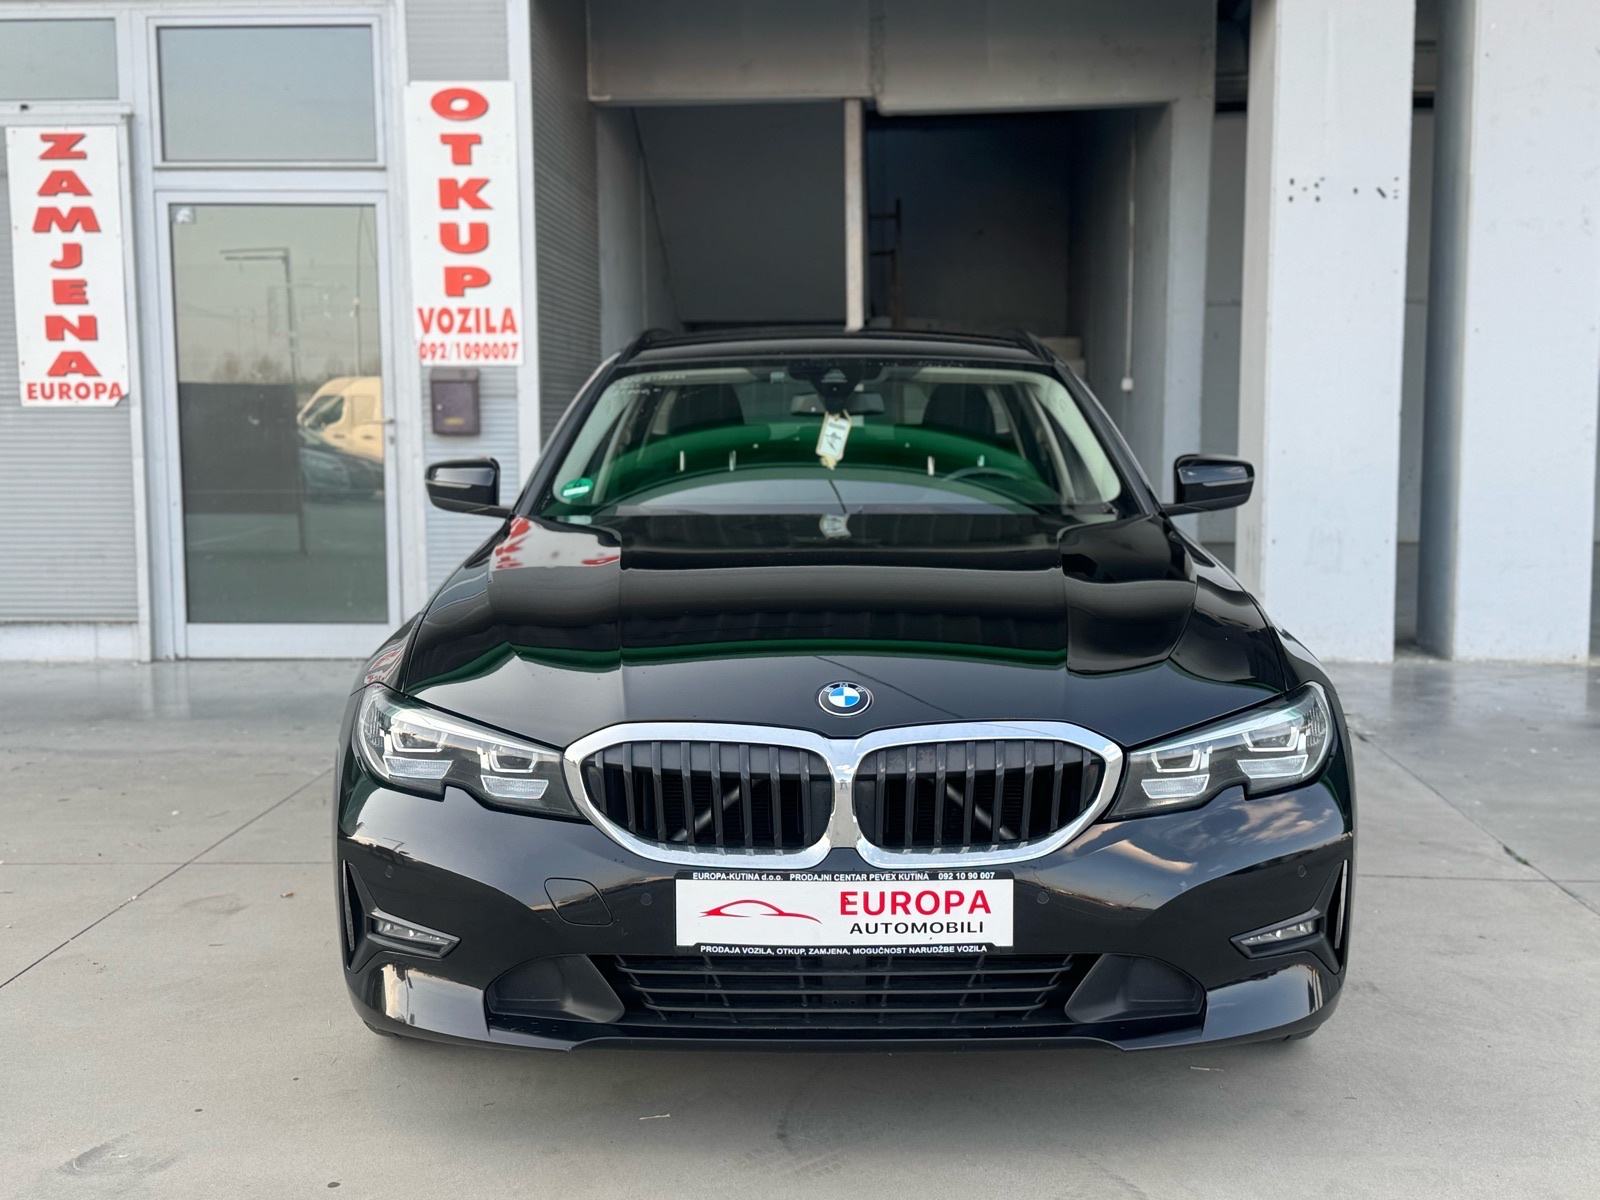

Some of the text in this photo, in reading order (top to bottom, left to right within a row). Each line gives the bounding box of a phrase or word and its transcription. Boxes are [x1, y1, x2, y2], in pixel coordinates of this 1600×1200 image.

[430, 87, 493, 298] OTKUP
[32, 132, 101, 377] ZAMJENA
[417, 307, 517, 334] VOZILA
[27, 382, 123, 400] EUROPA
[789, 873, 832, 882] PRODAJNI
[833, 873, 868, 882] CENTAR
[869, 873, 897, 881] PEVEX
[898, 872, 930, 881] KUTINA
[938, 872, 954, 880] 092
[955, 872, 966, 880] 10
[967, 872, 978, 880] 90
[979, 871, 996, 880] 007
[840, 890, 992, 916] EUROPA
[849, 921, 984, 934] AUTOMOBILI
[700, 945, 741, 954] PRODAJA
[908, 943, 955, 954] NARUDŽBE
[956, 944, 988, 954] VOZILA
